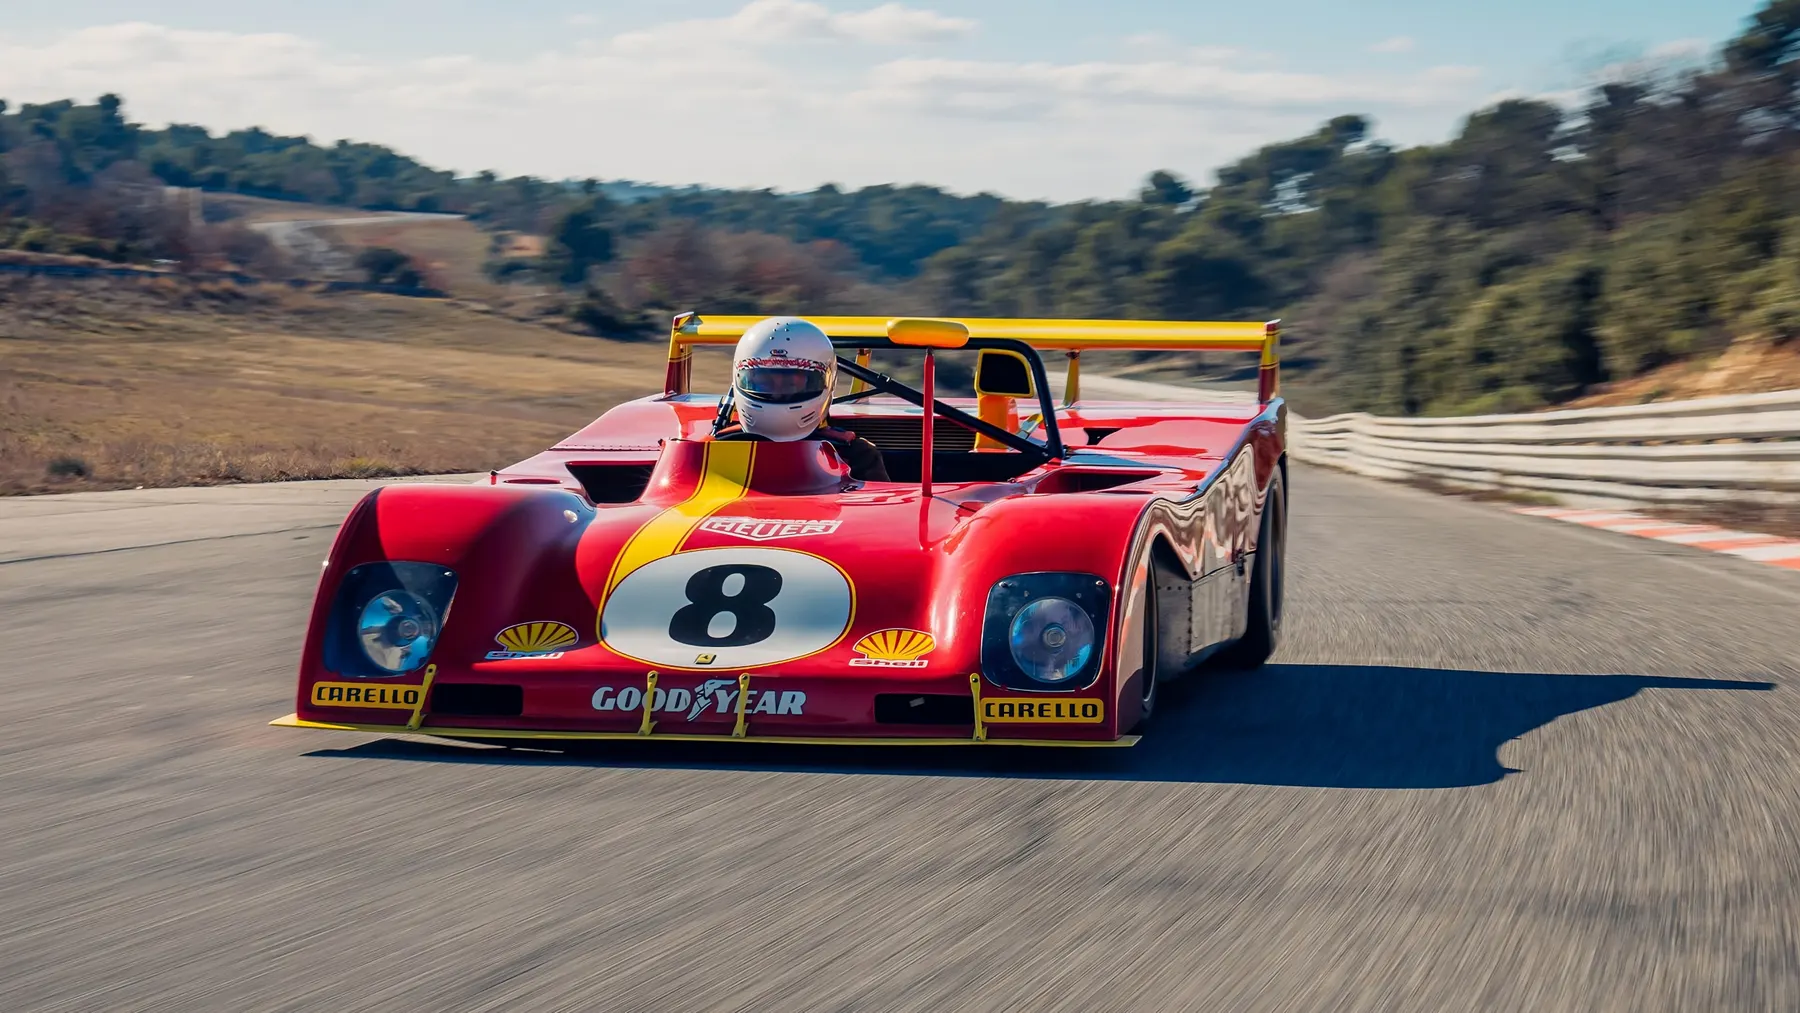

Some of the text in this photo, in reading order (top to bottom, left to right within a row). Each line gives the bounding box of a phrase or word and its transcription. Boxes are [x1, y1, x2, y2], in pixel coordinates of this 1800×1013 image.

[709, 519, 828, 538] HEUER
[668, 563, 783, 648] 8
[316, 686, 419, 705] CARELLO
[985, 702, 1098, 718] CARELLO
